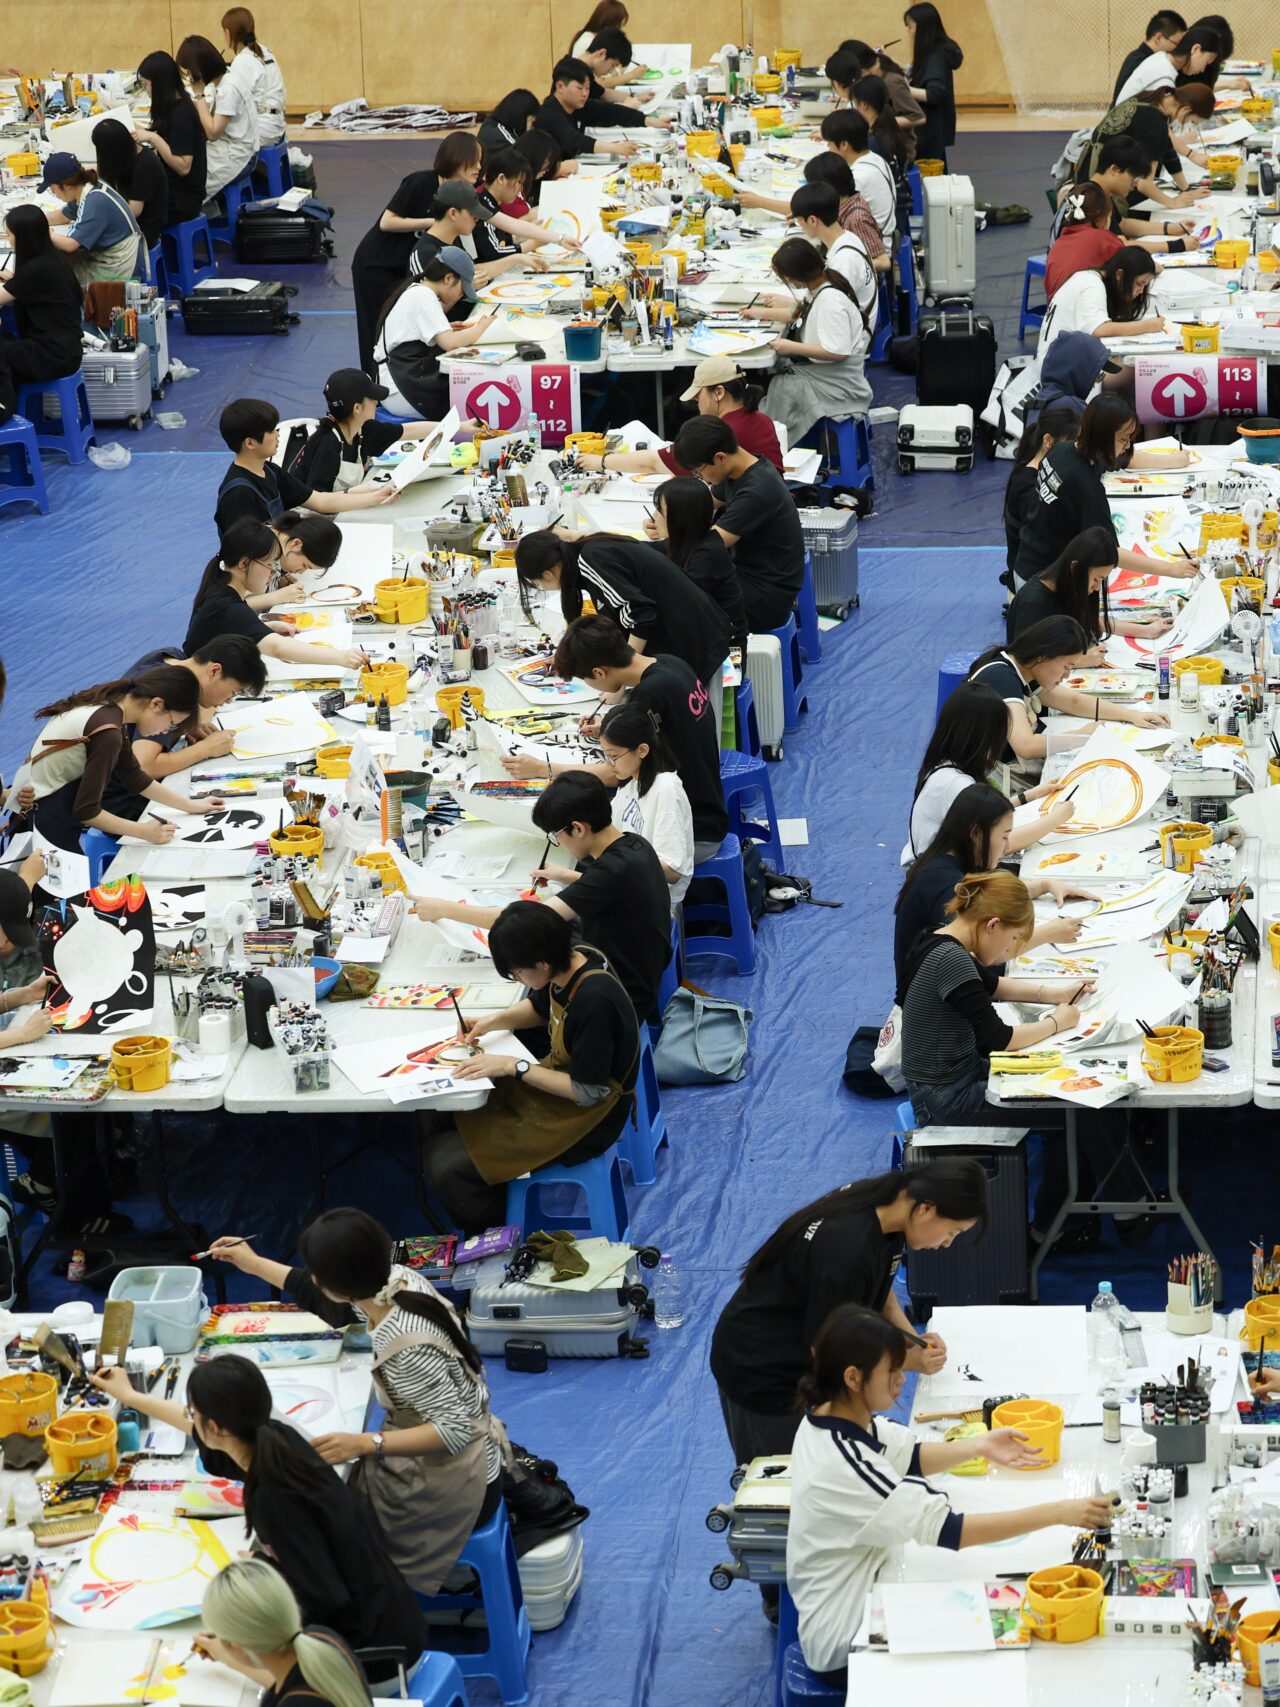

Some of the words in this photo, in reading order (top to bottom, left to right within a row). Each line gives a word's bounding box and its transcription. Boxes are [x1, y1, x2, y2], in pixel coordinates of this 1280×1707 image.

[1223, 367, 1252, 381] 113
[540, 375, 562, 390] 97
[539, 419, 567, 432] 112
